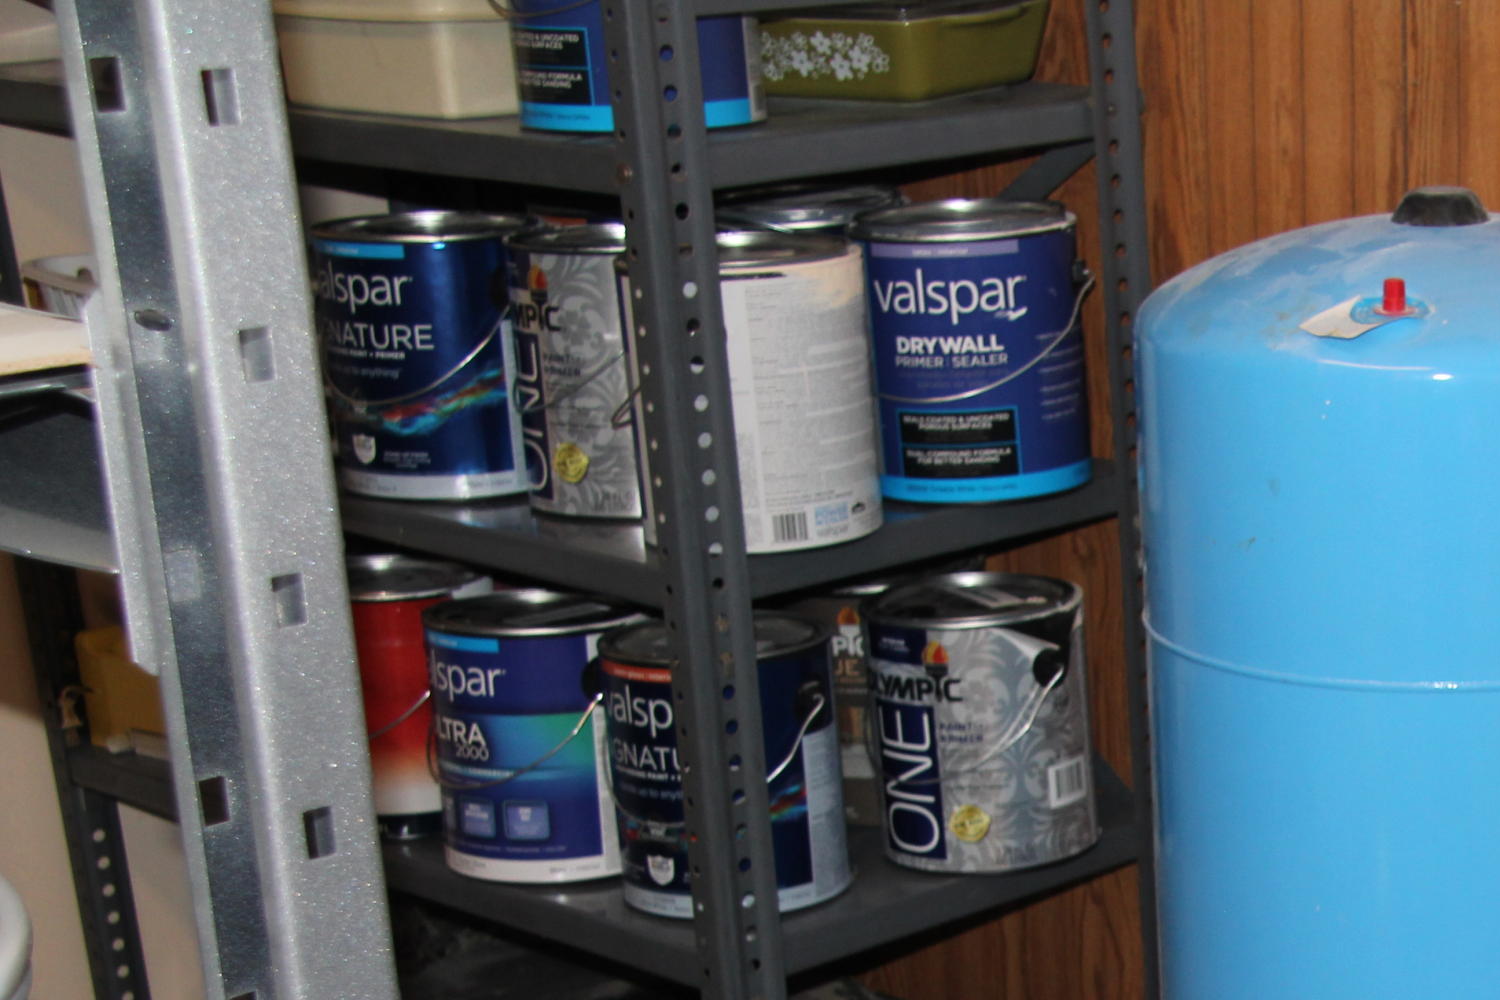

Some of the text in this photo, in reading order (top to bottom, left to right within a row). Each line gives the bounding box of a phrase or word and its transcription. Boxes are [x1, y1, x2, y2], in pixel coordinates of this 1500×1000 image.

[319, 260, 411, 315] alspar
[874, 268, 1027, 325] valspar
[327, 319, 435, 351] NATURE
[896, 334, 1005, 355] DRYWALL
[895, 353, 1008, 369] PRIMER SEALER
[430, 648, 503, 702] lspar
[435, 714, 486, 746] LTRA
[456, 744, 490, 761] 2000
[880, 705, 940, 854] ONE
